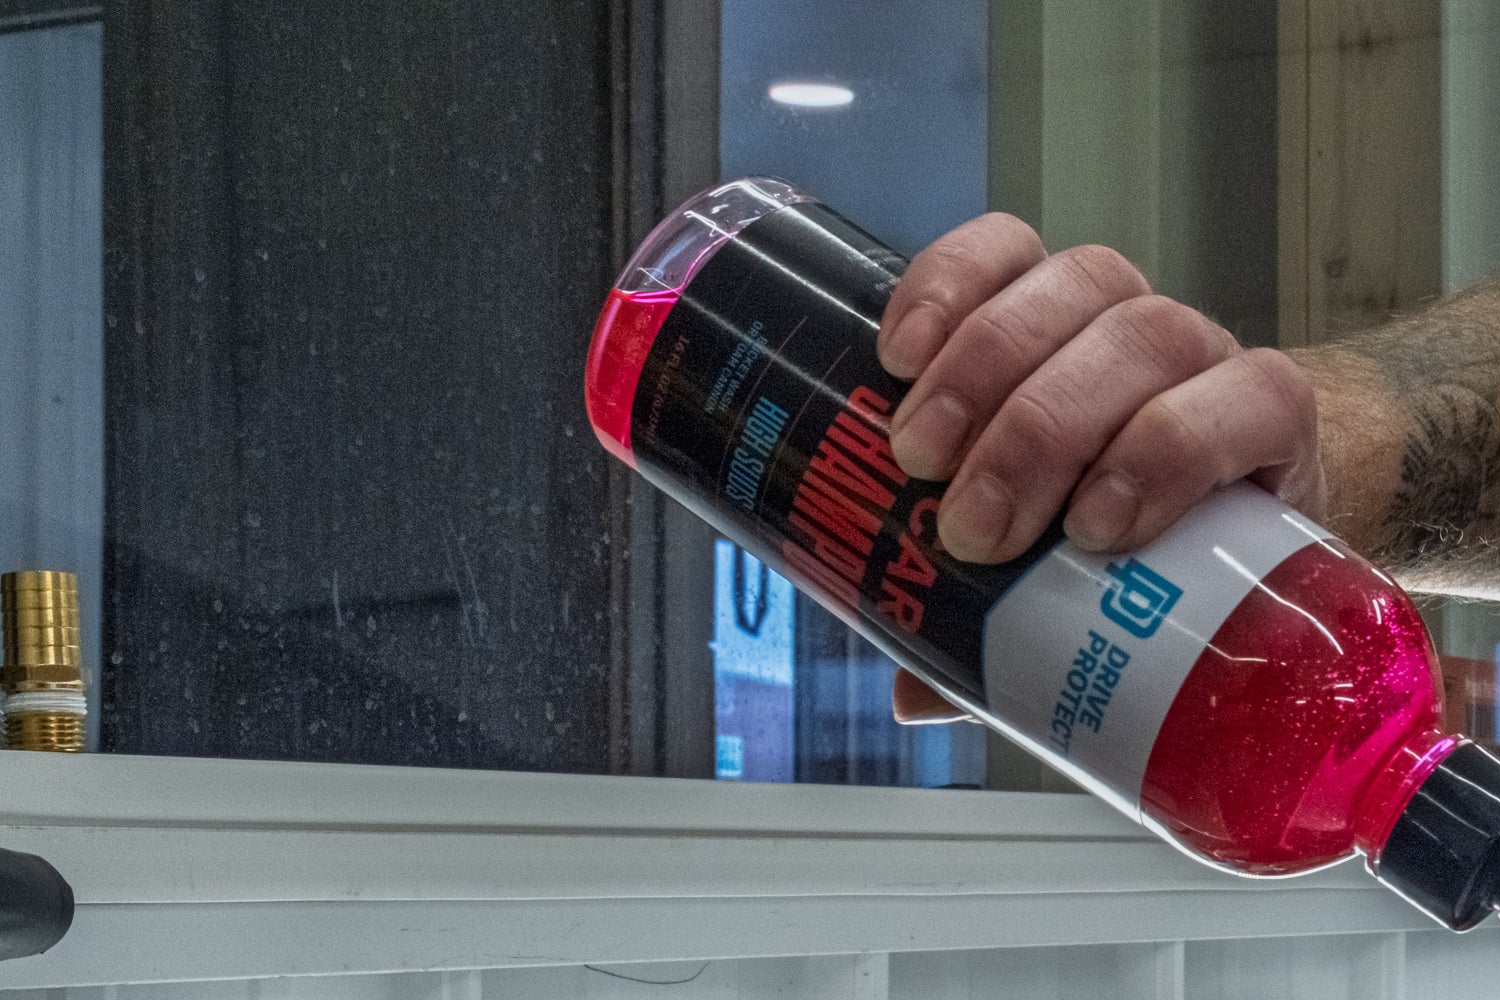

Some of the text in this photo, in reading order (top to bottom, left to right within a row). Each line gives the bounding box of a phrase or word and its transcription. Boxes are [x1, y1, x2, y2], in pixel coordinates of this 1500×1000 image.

[725, 396, 790, 511] HIGH SUDS
[876, 498, 944, 637] CAR
[1050, 629, 1109, 754] PROTECT
[1080, 644, 1132, 734] DRIVE
